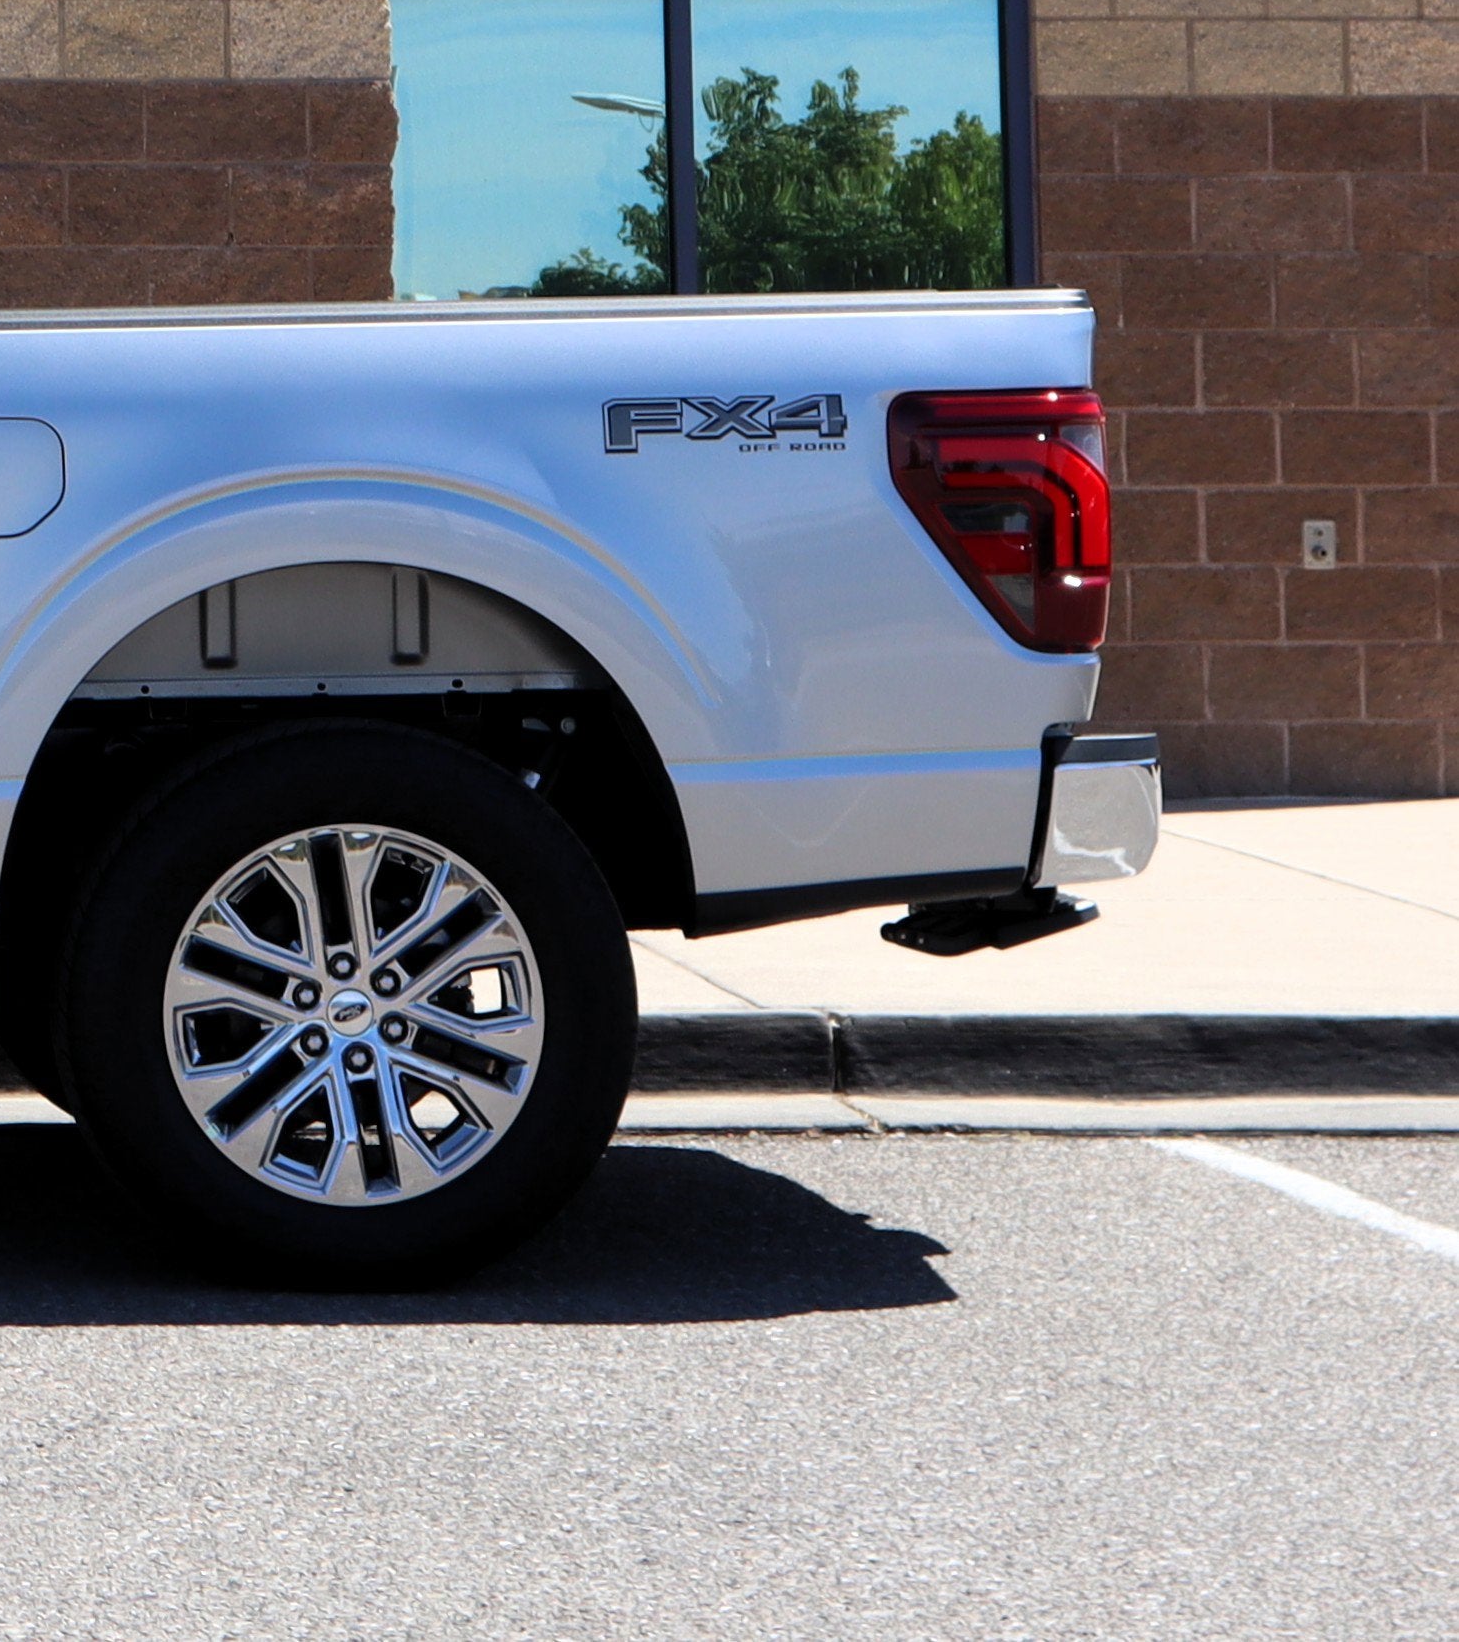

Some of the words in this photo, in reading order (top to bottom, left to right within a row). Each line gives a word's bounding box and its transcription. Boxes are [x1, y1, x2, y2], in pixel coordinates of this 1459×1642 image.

[601, 393, 848, 454] FX4
[738, 443, 781, 453] OFF
[789, 442, 847, 452] ROAD
